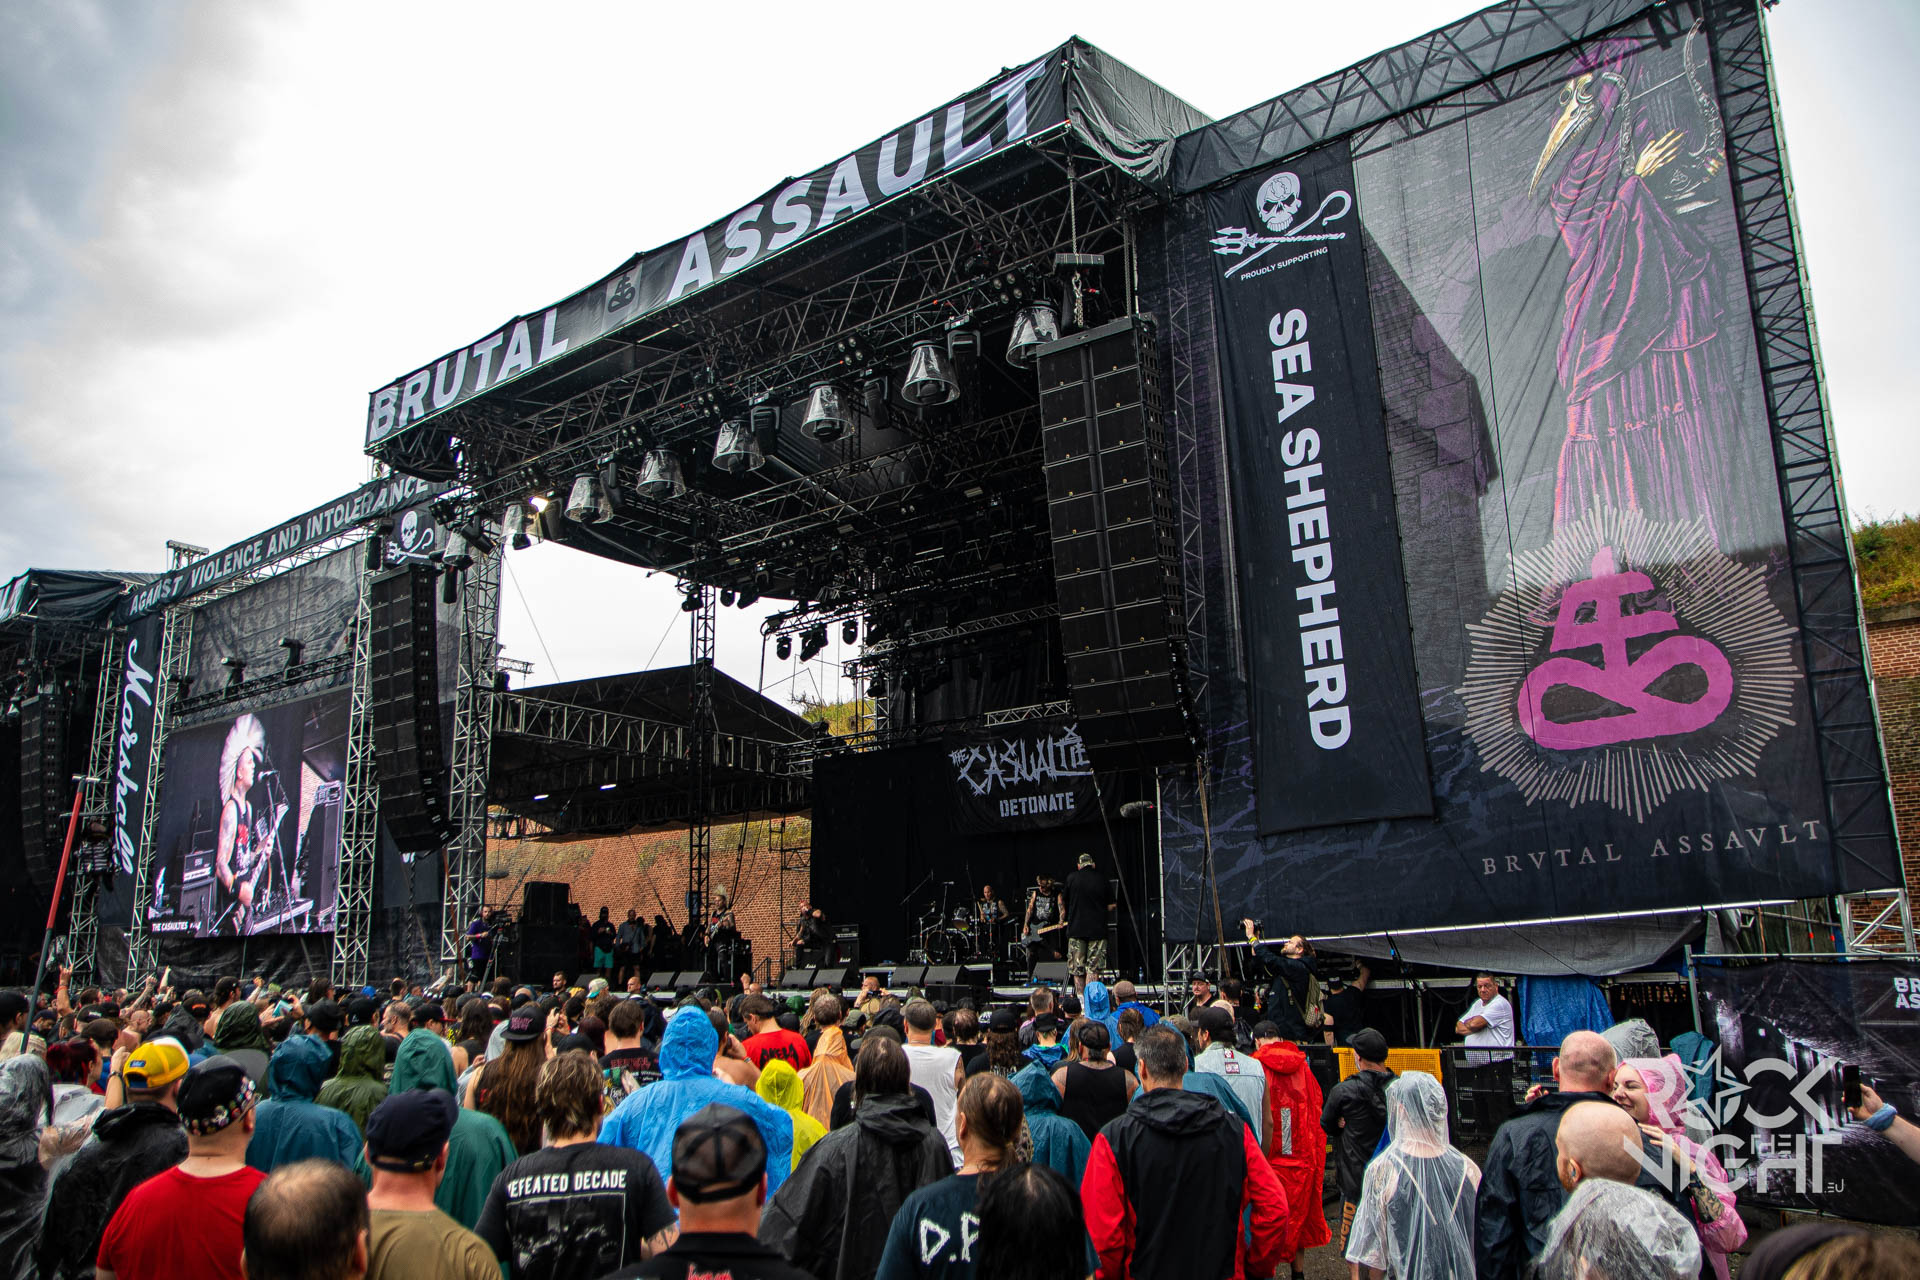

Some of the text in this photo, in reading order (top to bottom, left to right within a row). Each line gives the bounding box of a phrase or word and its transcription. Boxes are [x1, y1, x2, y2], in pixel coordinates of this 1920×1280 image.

[369, 58, 1047, 442] BRUTAL ASSAULT
[1240, 246, 1329, 281] PROUDLY SUPPORTING
[189, 543, 264, 589] VIOLENCE
[266, 523, 302, 558] AND
[304, 476, 430, 543] INTOLERANCE
[1268, 308, 1352, 751] SEA SHEPHERD
[112, 638, 154, 875] Marshall
[948, 722, 1094, 797] THE CASUALTIE
[1000, 791, 1075, 818] DETONATE
[1481, 820, 1821, 876] BRVTAL ASSAVLT
[151, 922, 162, 933] THE
[574, 1169, 629, 1192] DECADE
